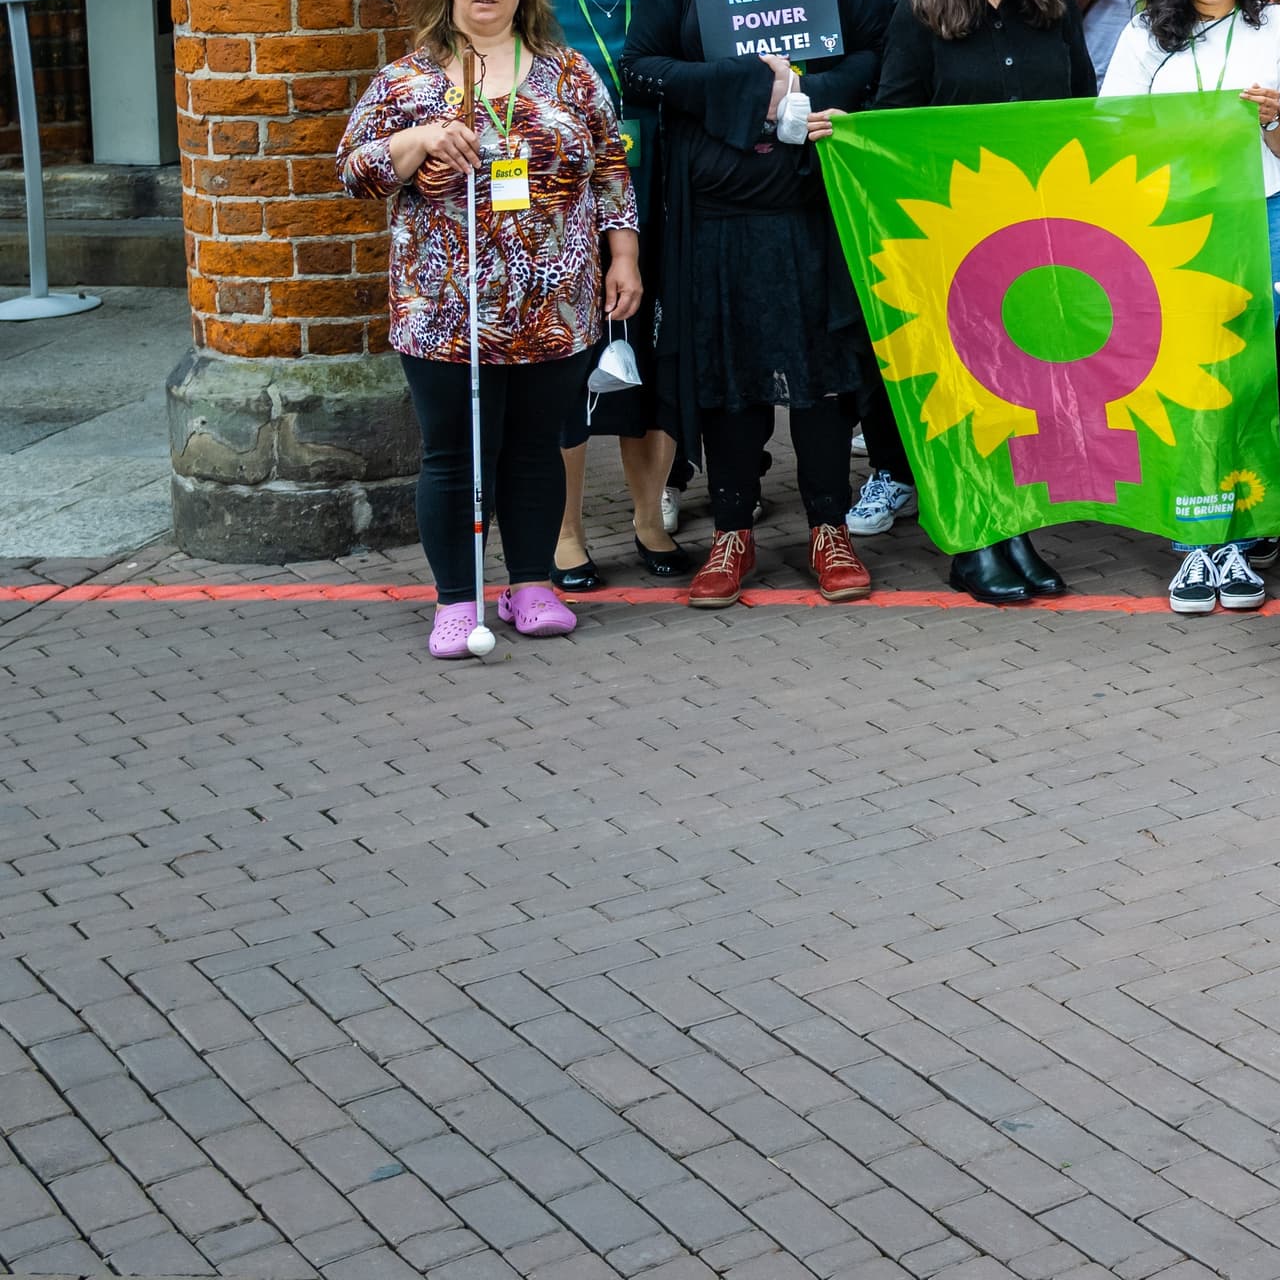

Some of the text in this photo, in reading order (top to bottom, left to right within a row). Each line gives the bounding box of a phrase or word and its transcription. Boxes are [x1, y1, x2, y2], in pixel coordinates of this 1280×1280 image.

[731, 6, 808, 32] POWER
[735, 32, 811, 57] MALTE!
[1175, 492, 1236, 506] BÜNDNIS 90
[1175, 502, 1234, 516] DIE GRÜNEN
